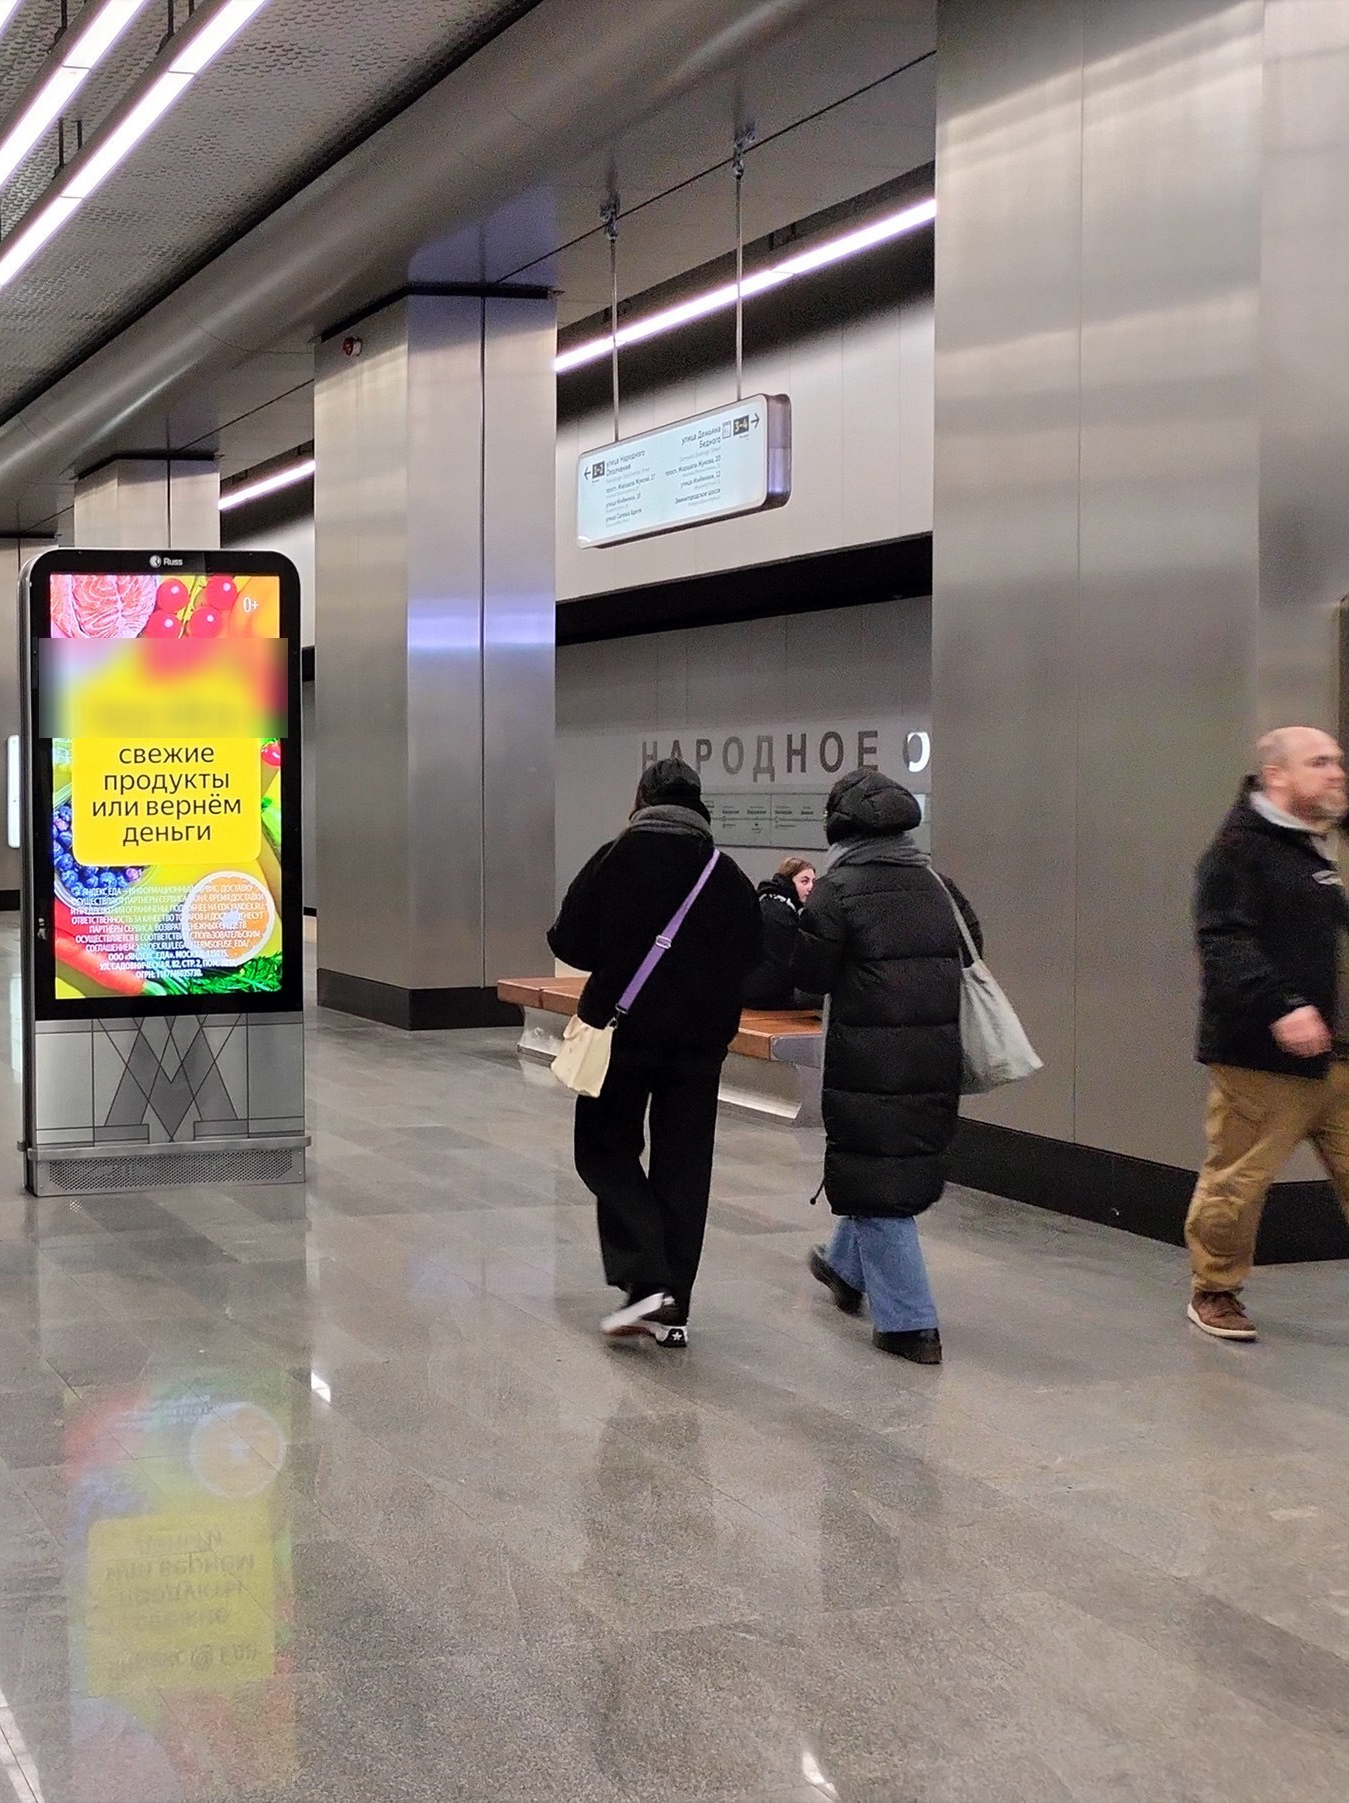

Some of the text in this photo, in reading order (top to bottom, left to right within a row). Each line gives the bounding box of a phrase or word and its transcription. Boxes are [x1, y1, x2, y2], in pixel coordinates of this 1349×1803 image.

[163, 557, 183, 566] Russ
[243, 597, 259, 613] 0+
[118, 746, 214, 764] свежие
[642, 730, 879, 783] НАРОДНОЕ
[103, 771, 229, 795] продукты
[92, 794, 242, 820] или вернём
[122, 825, 212, 847] деньги
